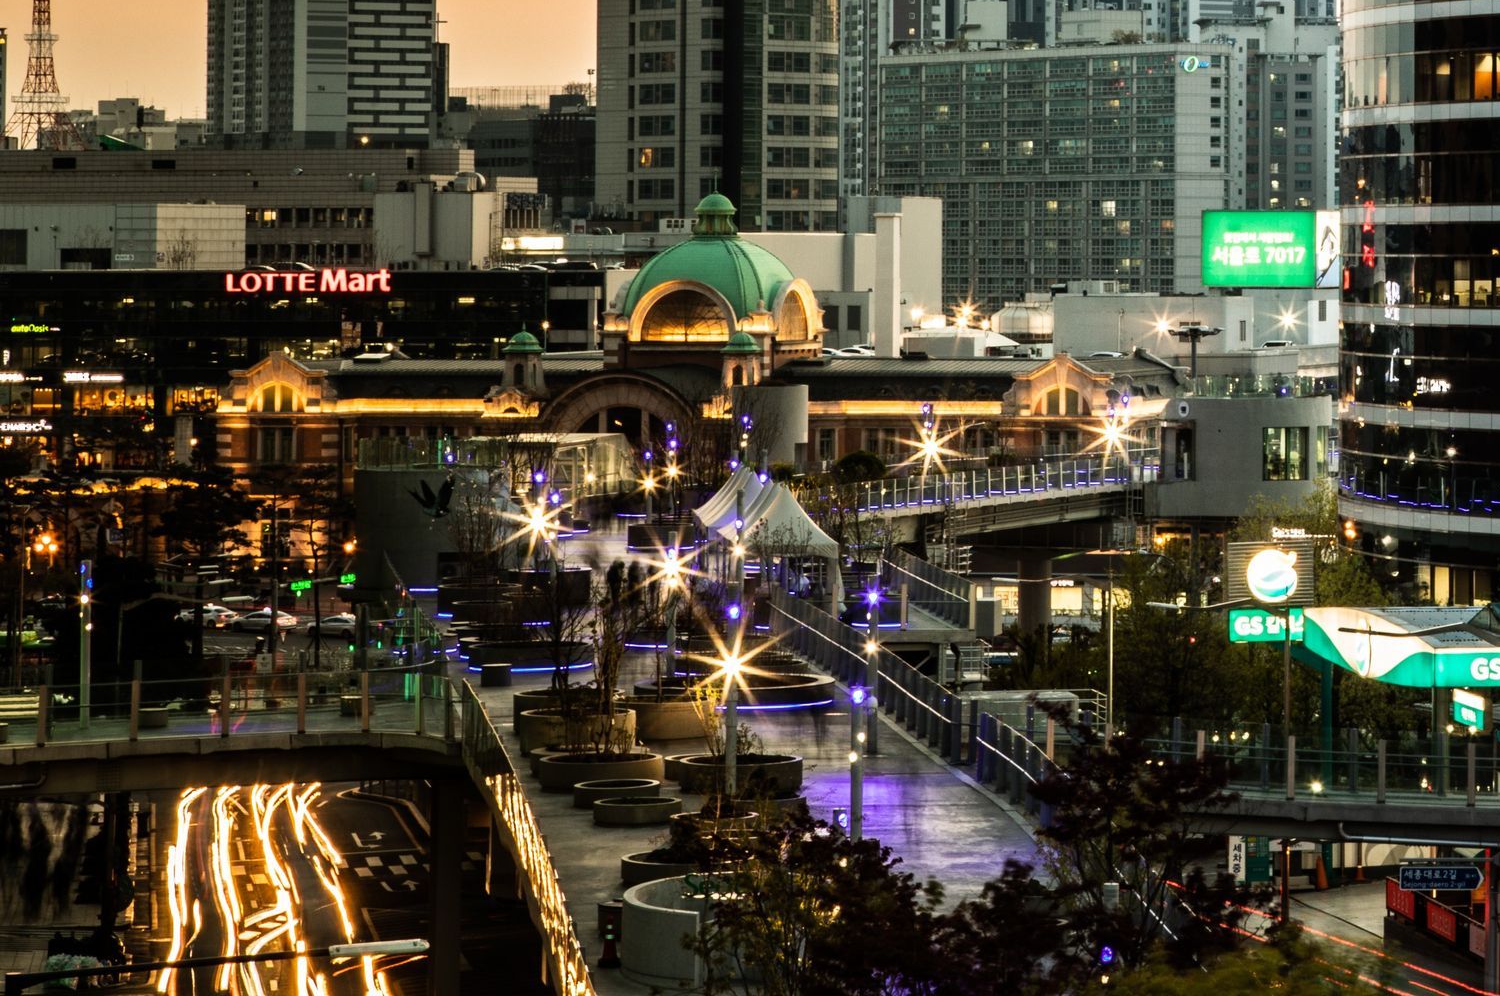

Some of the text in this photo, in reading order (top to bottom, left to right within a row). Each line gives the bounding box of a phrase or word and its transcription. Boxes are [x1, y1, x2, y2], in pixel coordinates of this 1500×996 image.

[1264, 246, 1306, 264] 7017
[226, 268, 391, 293] LOTTE Mart
[1234, 615, 1264, 636] GS
[1233, 844, 1242, 873] 세차중
